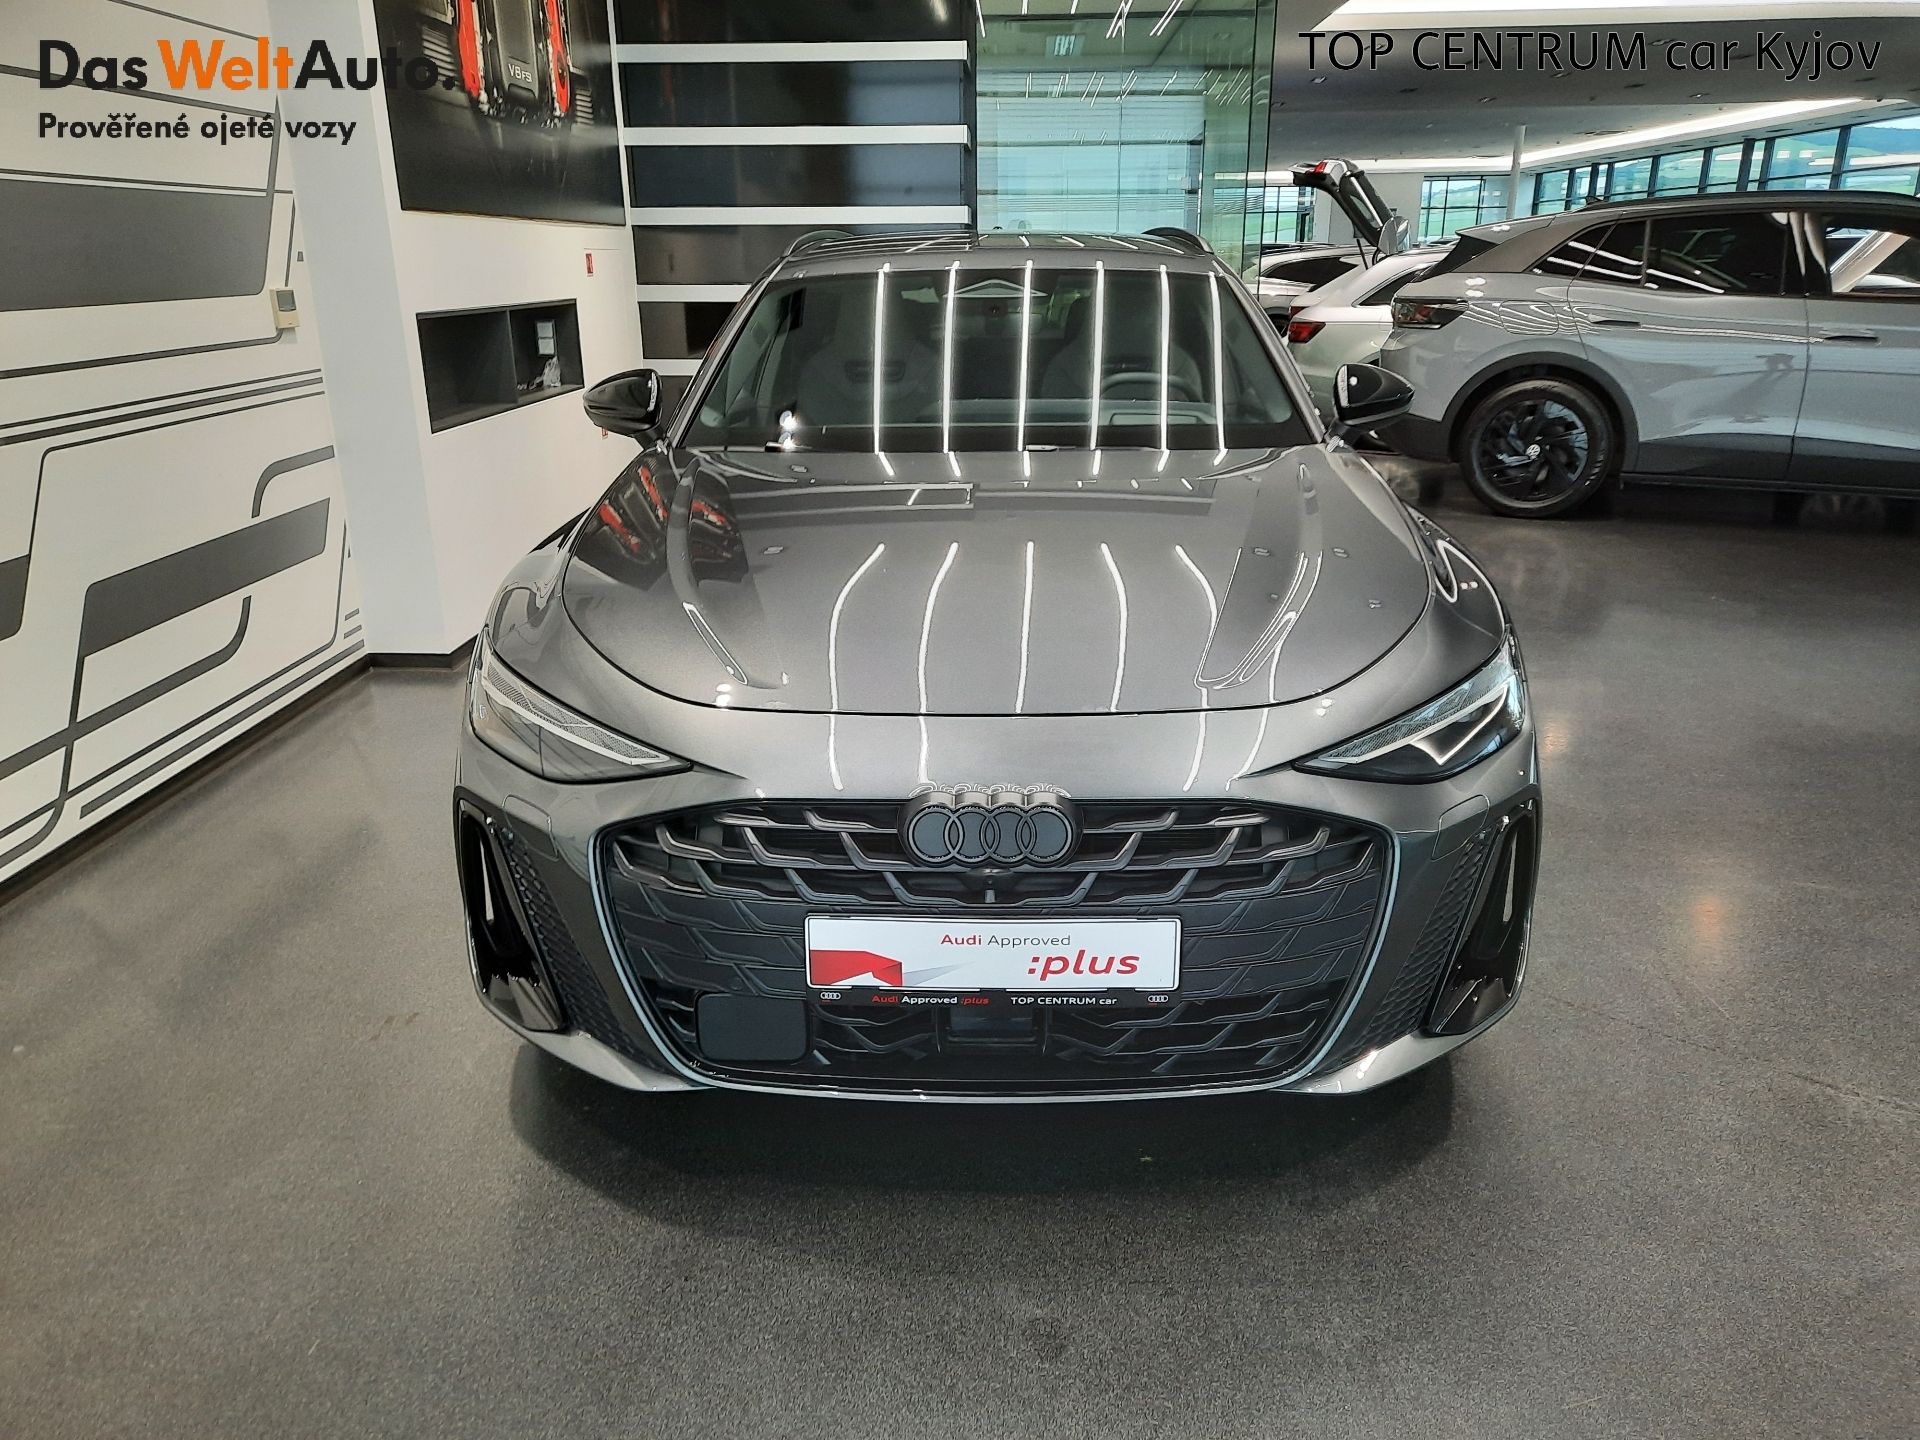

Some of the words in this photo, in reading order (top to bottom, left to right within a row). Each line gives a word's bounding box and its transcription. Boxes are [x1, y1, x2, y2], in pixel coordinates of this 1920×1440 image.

[508, 63, 521, 79] V8
[940, 934, 982, 946] Audi
[987, 934, 1071, 950] Approved
[1027, 949, 1140, 981] :plus
[871, 995, 899, 1003] Audi
[901, 995, 958, 1005] Approved
[1010, 996, 1035, 1005] TOP
[1037, 996, 1096, 1005] CENTRUM
[1099, 997, 1118, 1005] car
